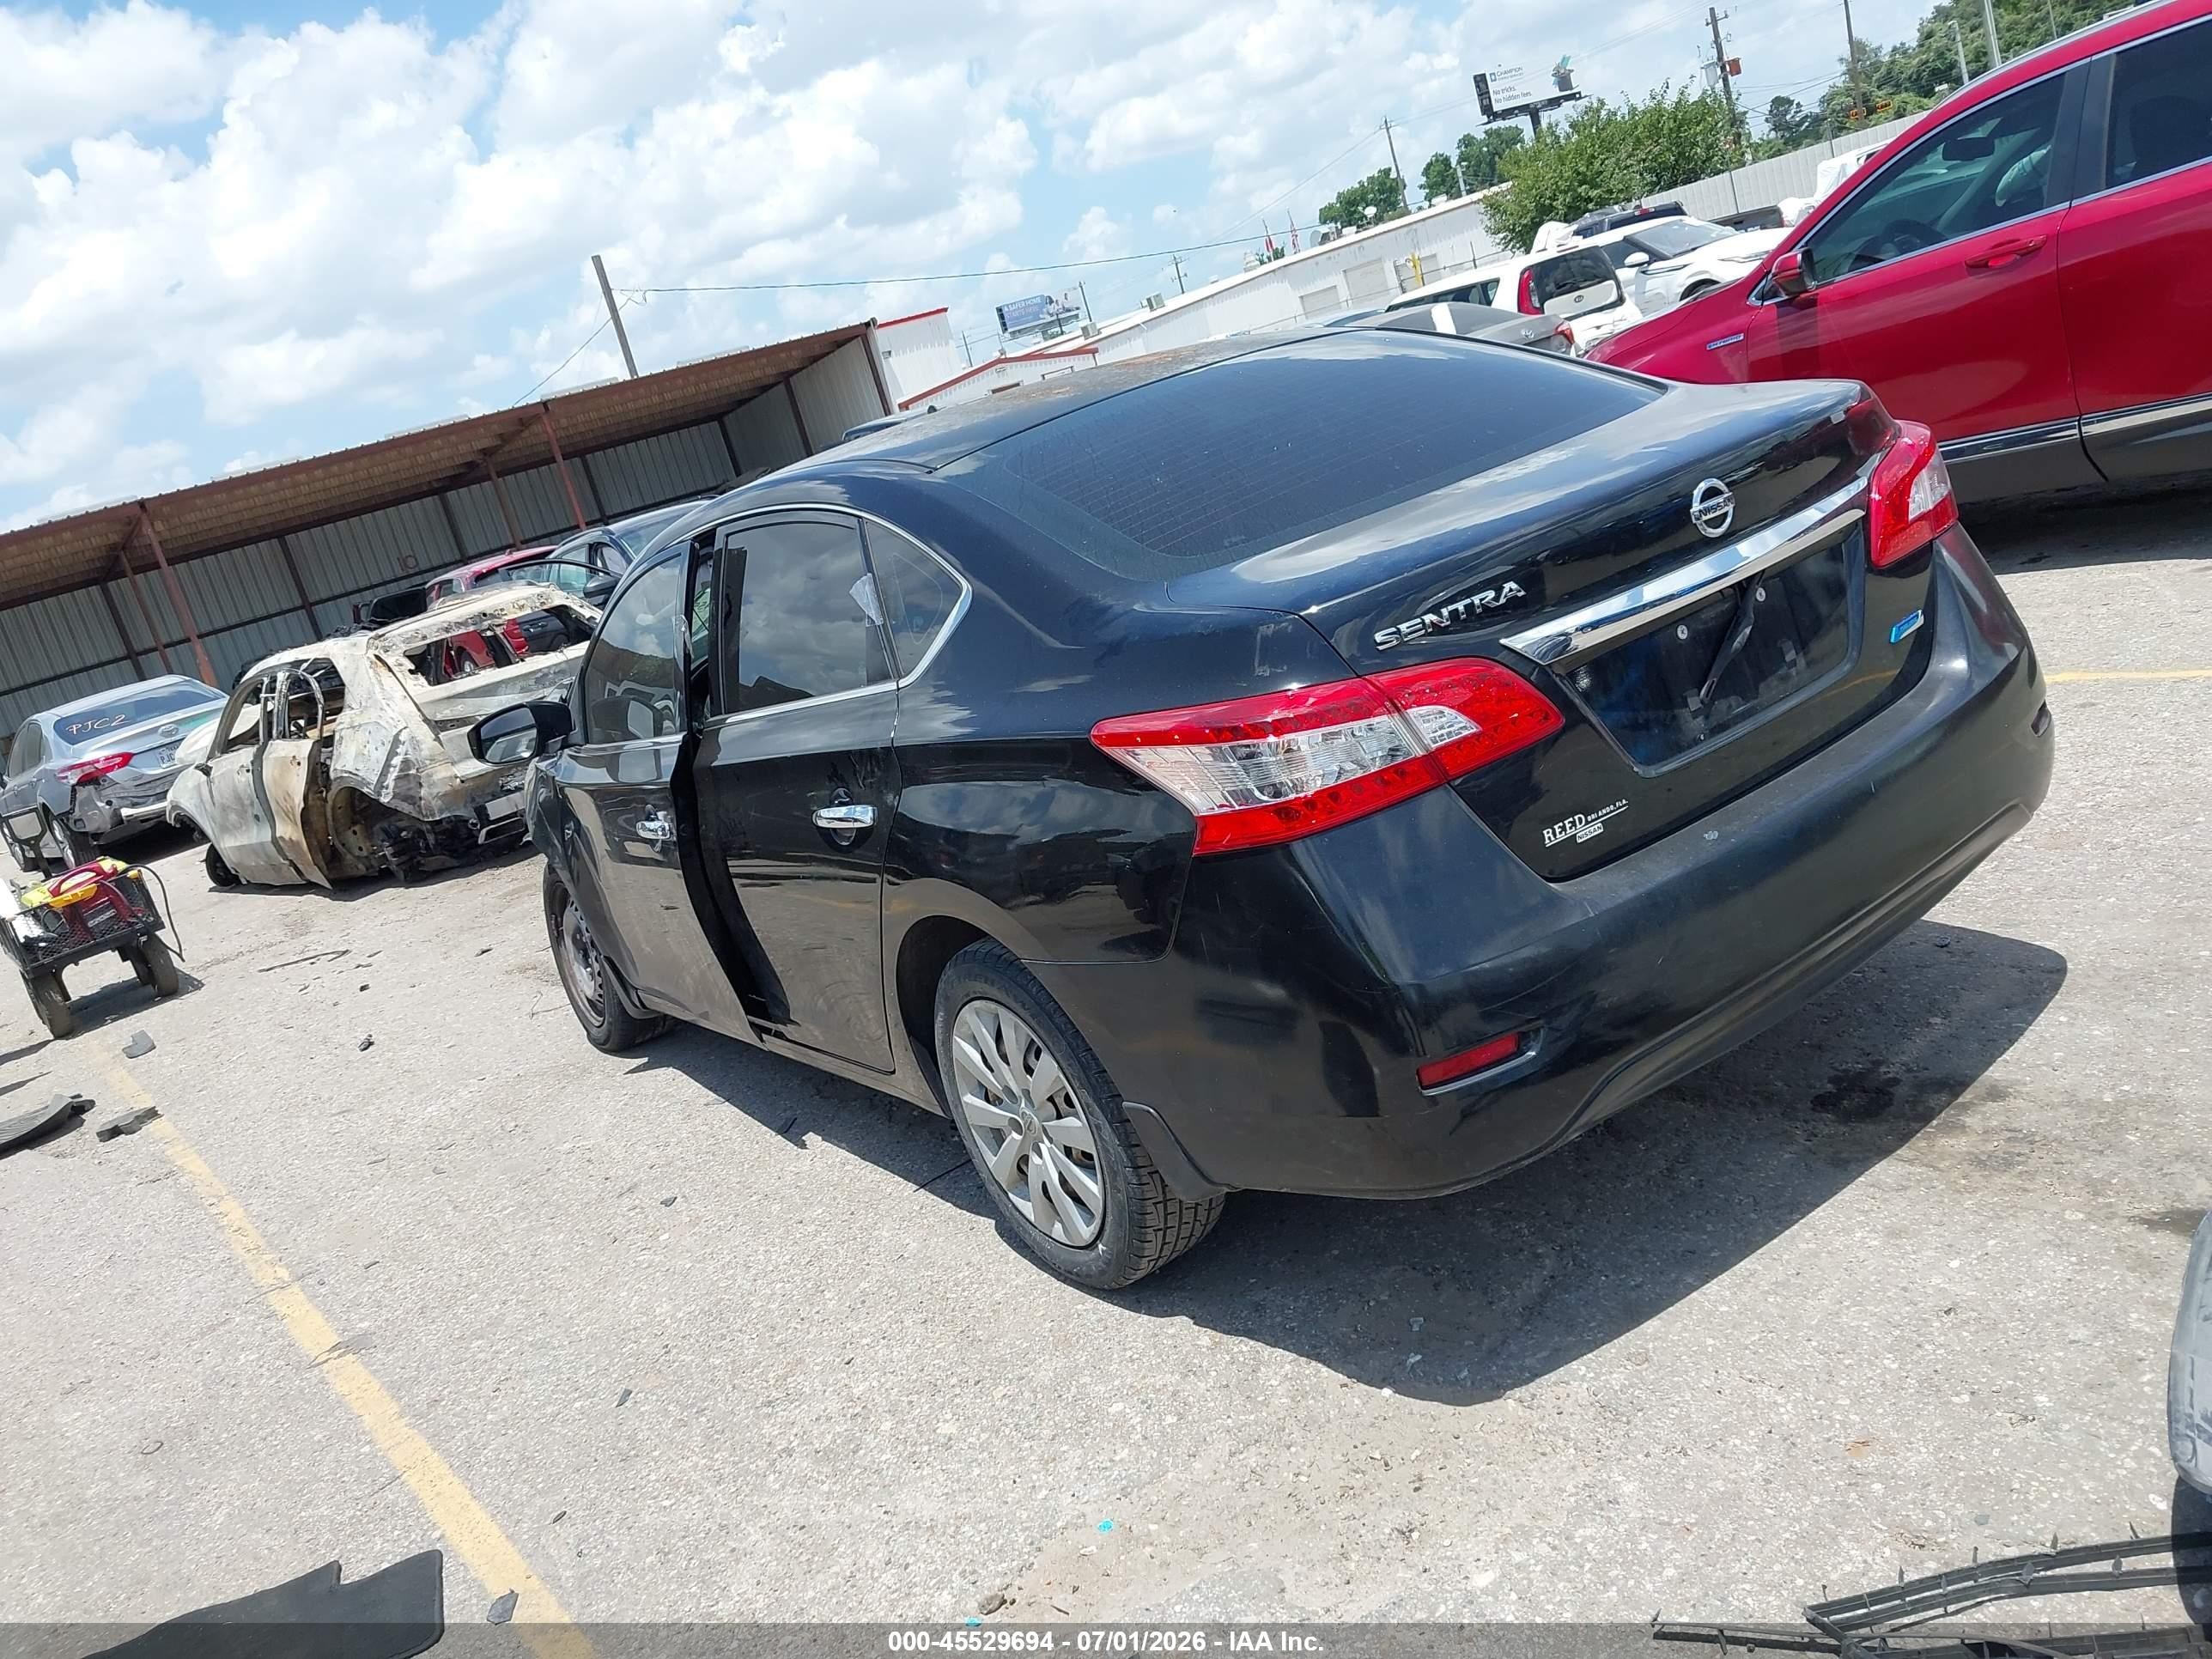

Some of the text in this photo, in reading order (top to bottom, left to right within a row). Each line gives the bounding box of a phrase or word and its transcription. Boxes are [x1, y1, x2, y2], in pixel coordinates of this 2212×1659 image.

[1009, 301, 1025, 310] SAFER
[1026, 296, 1042, 307] HOME
[1698, 495, 1734, 518] NISSAN
[1374, 580, 1527, 651] SENTRA
[1543, 813, 1586, 844] REED
[1577, 824, 1602, 842] NISSAN
